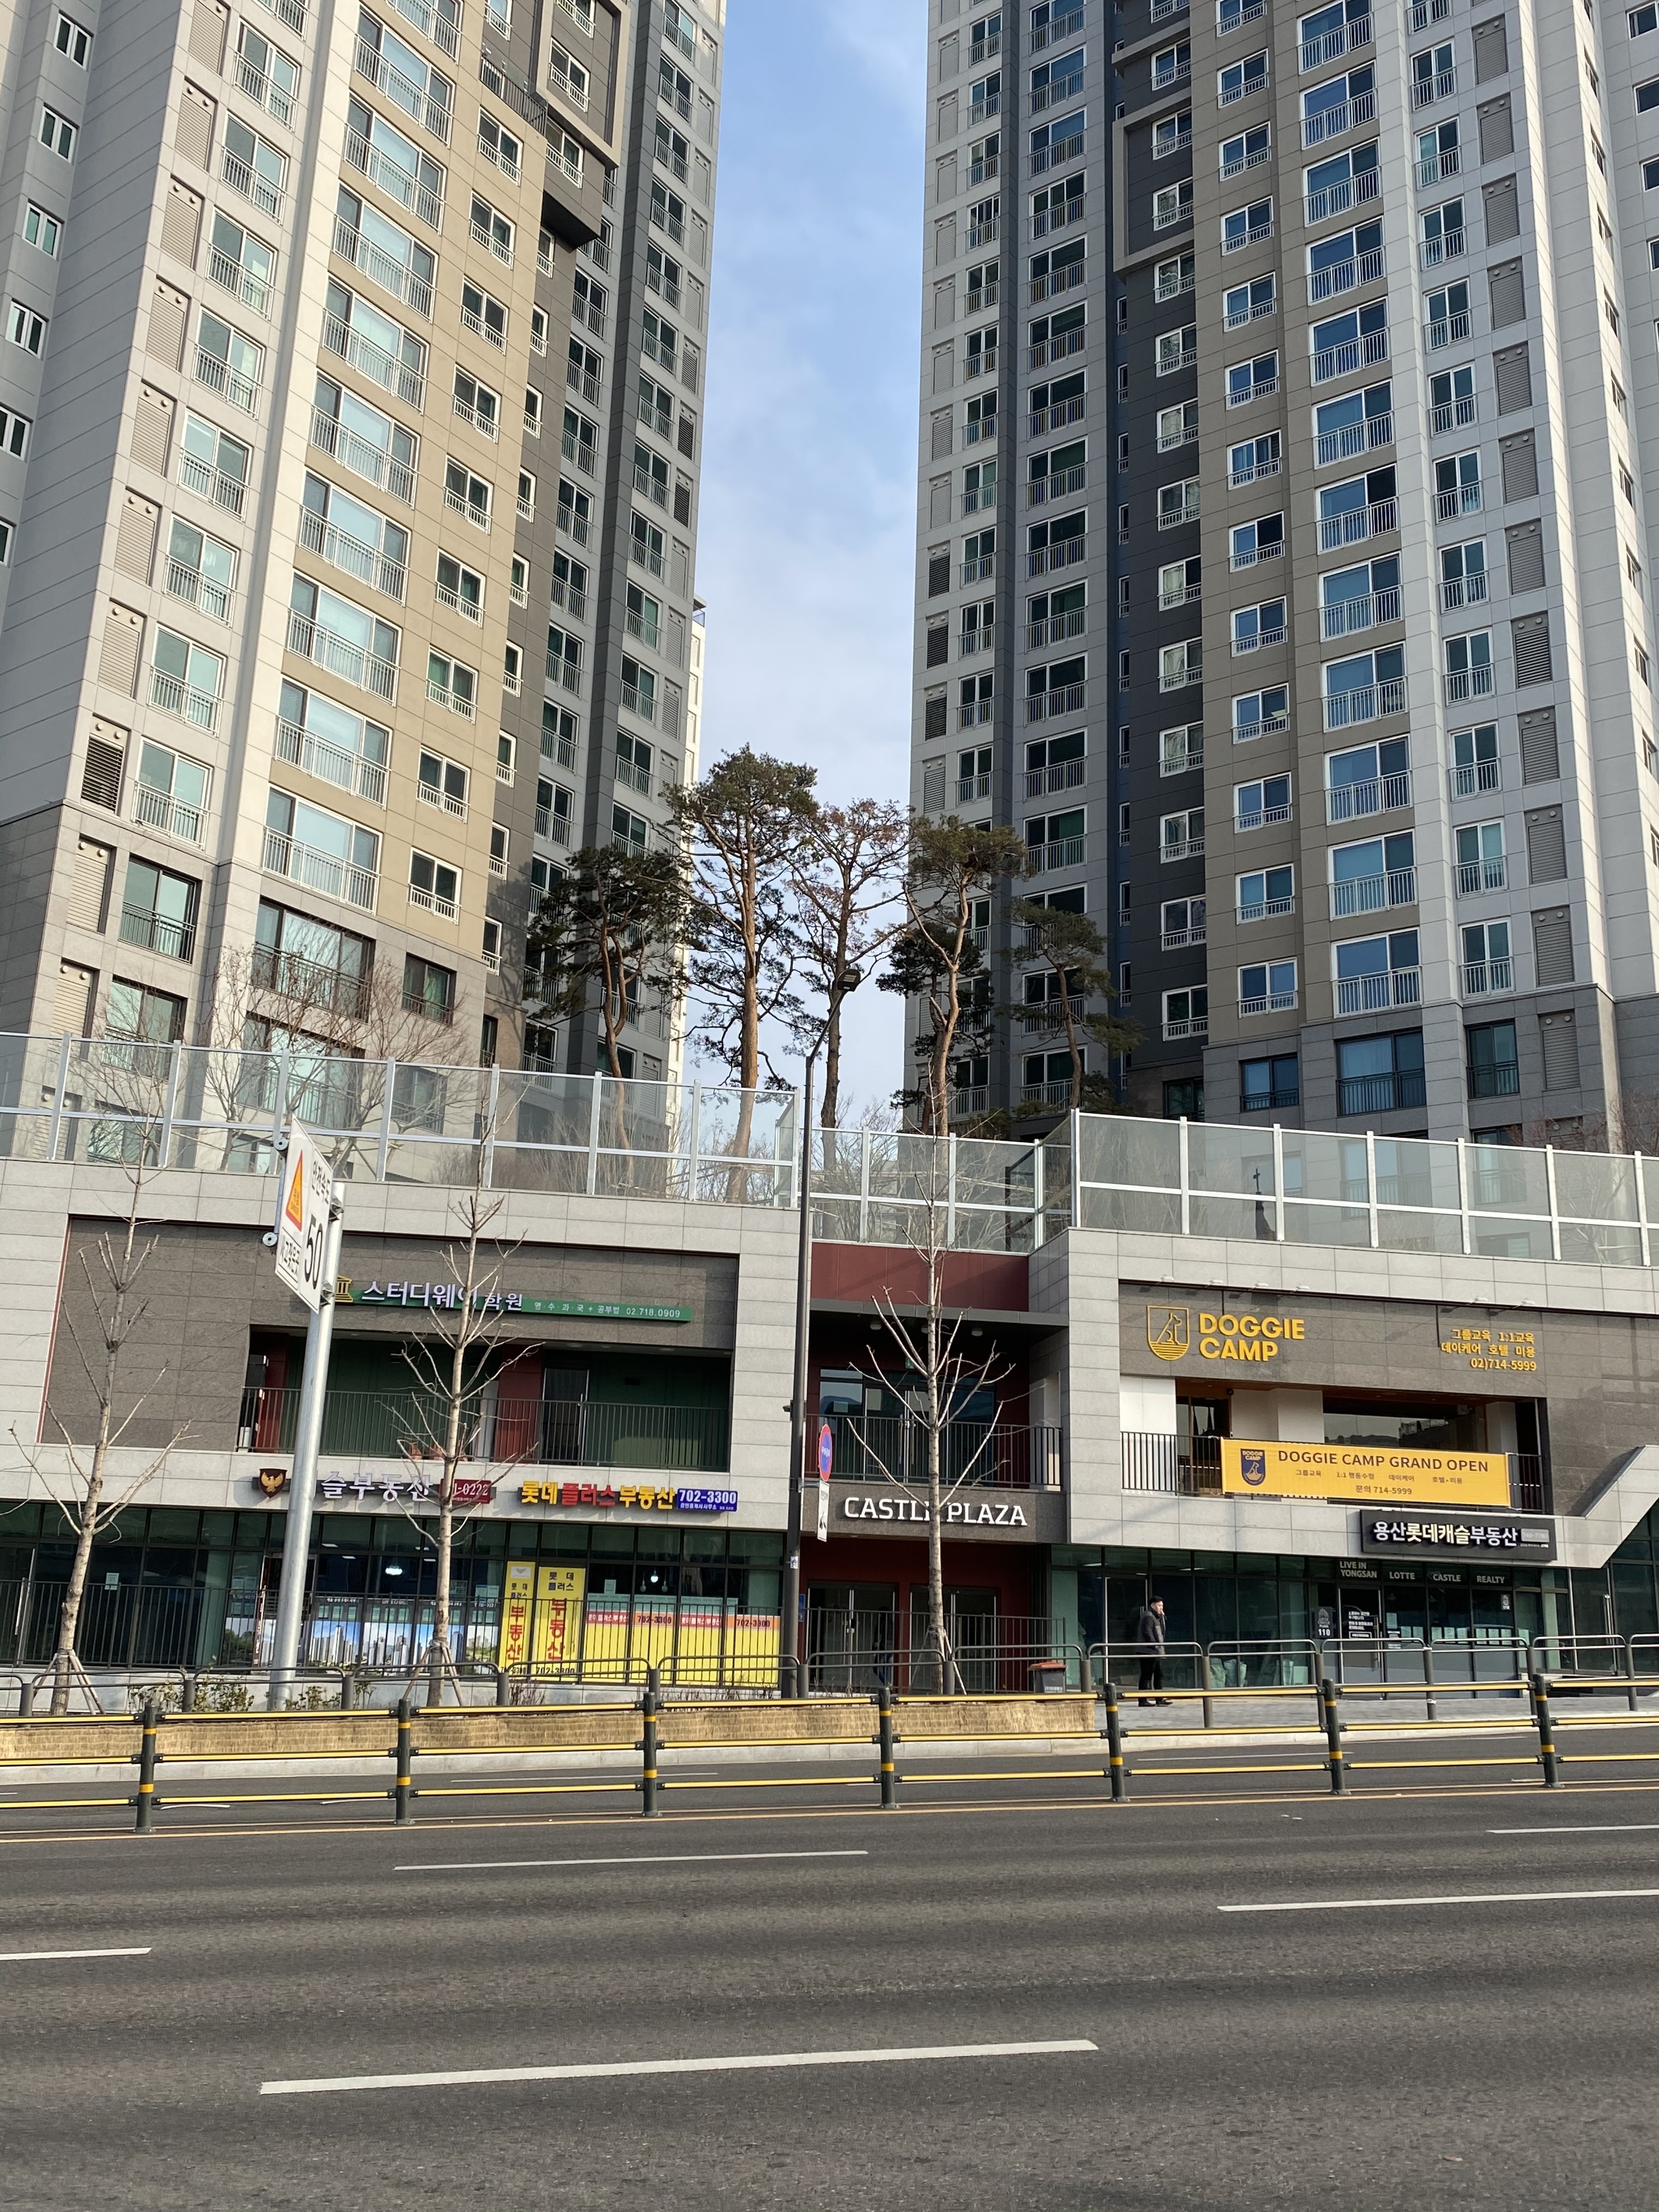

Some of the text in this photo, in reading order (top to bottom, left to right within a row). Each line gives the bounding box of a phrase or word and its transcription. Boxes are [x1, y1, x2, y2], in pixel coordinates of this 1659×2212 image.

[312, 1160, 330, 1205] 안전속도
[305, 1214, 323, 1290] 50
[362, 1280, 523, 1311] 스터디웨이 학원
[597, 1305, 620, 1314] 공부법
[626, 1308, 680, 1318] 02.718.0909
[1199, 1313, 1305, 1340] DOGGIE
[1451, 1329, 1535, 1344] 그룹교육 1:1교육
[1199, 1337, 1278, 1362] CAMP
[1441, 1342, 1536, 1358] 데이케어 호텔 미용
[1470, 1358, 1537, 1371] 02)714-5999
[1278, 1451, 1488, 1472] DOGGIE CAMP GRAND OPEN
[317, 1471, 434, 1502] 슬부동산
[679, 1489, 737, 1504] 702-3300
[1356, 1485, 1412, 1495] 문의 714-5999
[946, 1502, 1028, 1526] PLAZA
[1340, 1561, 1357, 1569] LIVE
[1341, 1569, 1378, 1578] YONGSAN
[1389, 1571, 1505, 1584] LOTTE CASTLE REALTY
[507, 1606, 524, 1661] 부동산
[548, 1598, 568, 1661] 부동산
